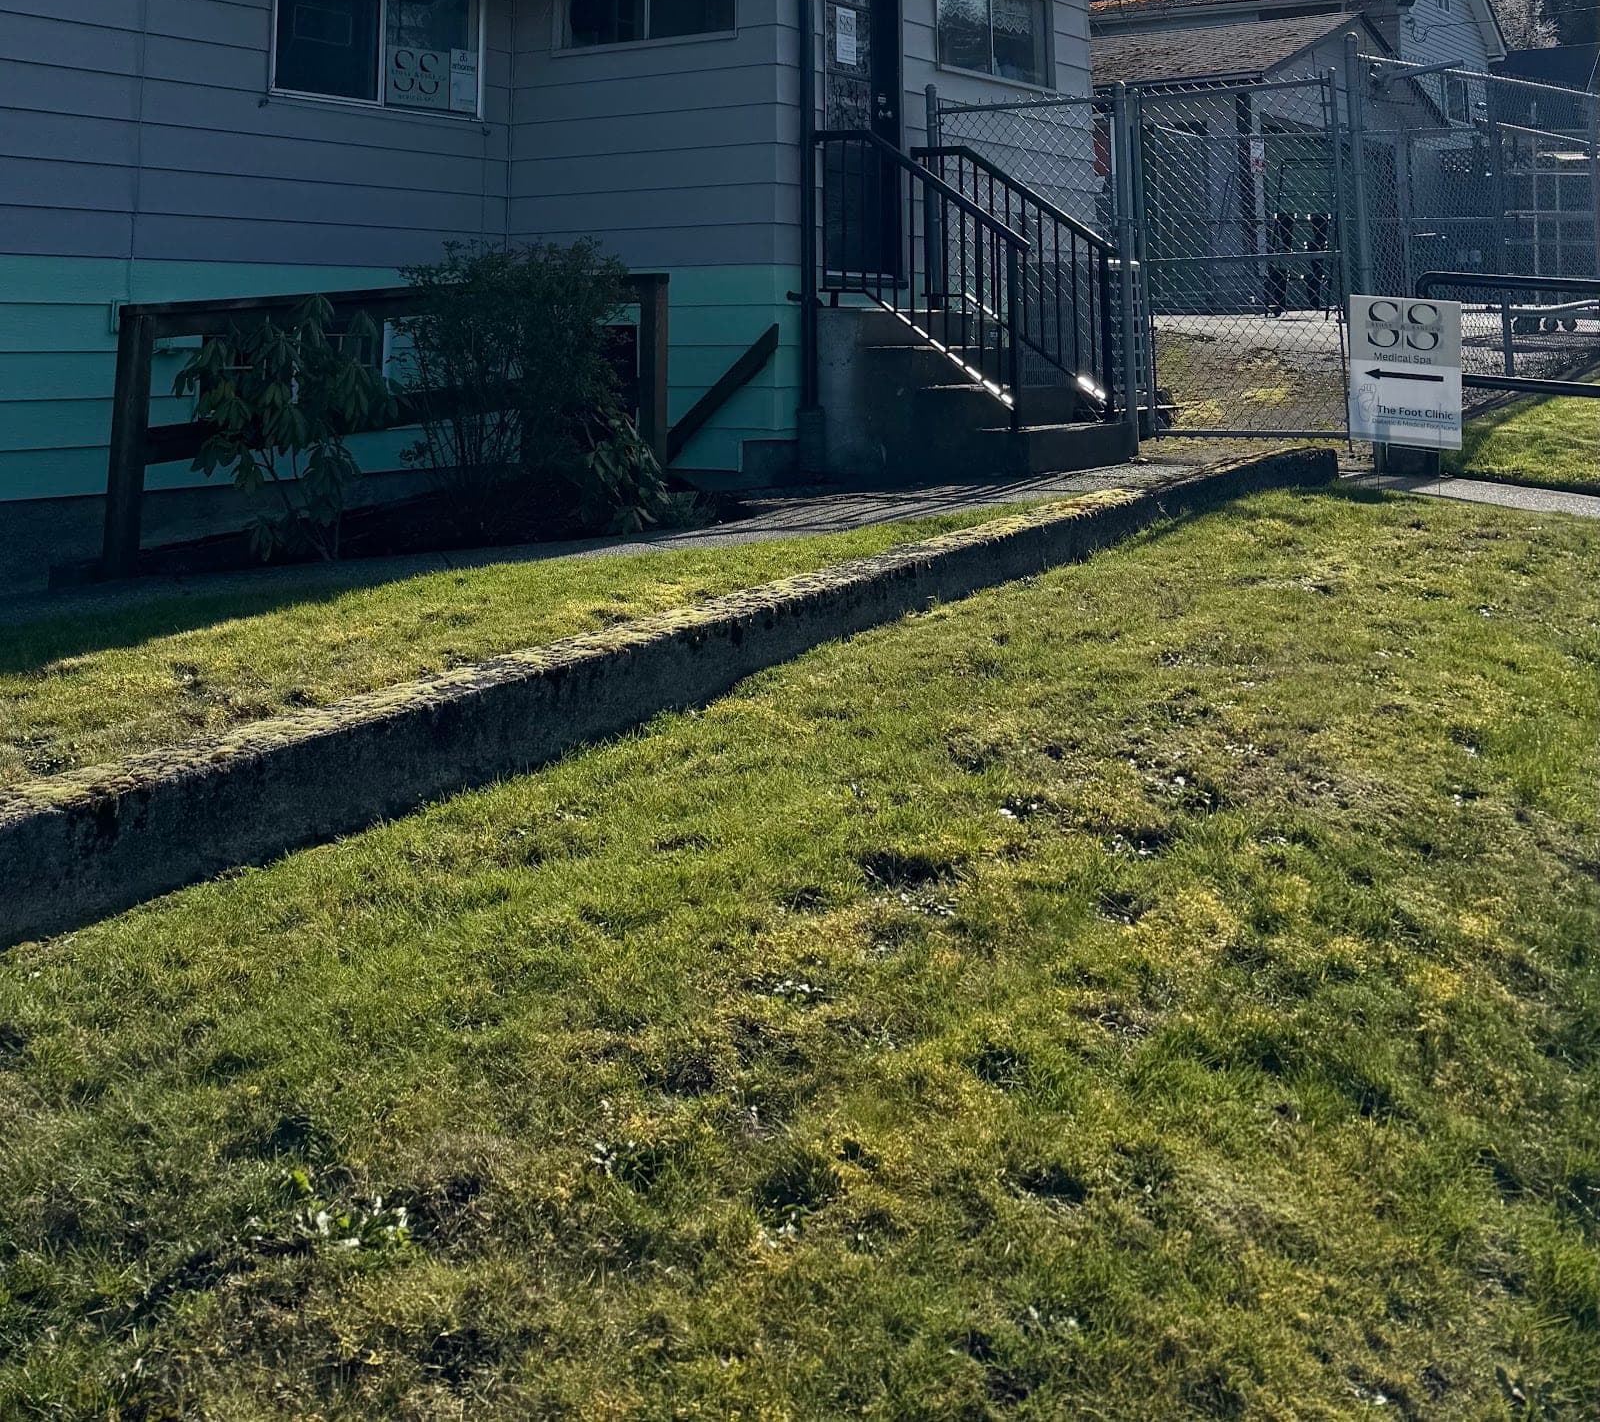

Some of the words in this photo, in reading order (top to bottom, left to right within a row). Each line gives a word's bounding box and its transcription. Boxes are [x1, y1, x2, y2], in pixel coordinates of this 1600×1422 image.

[1374, 352, 1411, 363] Medical
[1413, 355, 1432, 365] Spa
[1377, 404, 1396, 415] The
[1399, 407, 1422, 417] Foot
[1425, 409, 1454, 420] Clinic
[1402, 420, 1426, 428] Medical
